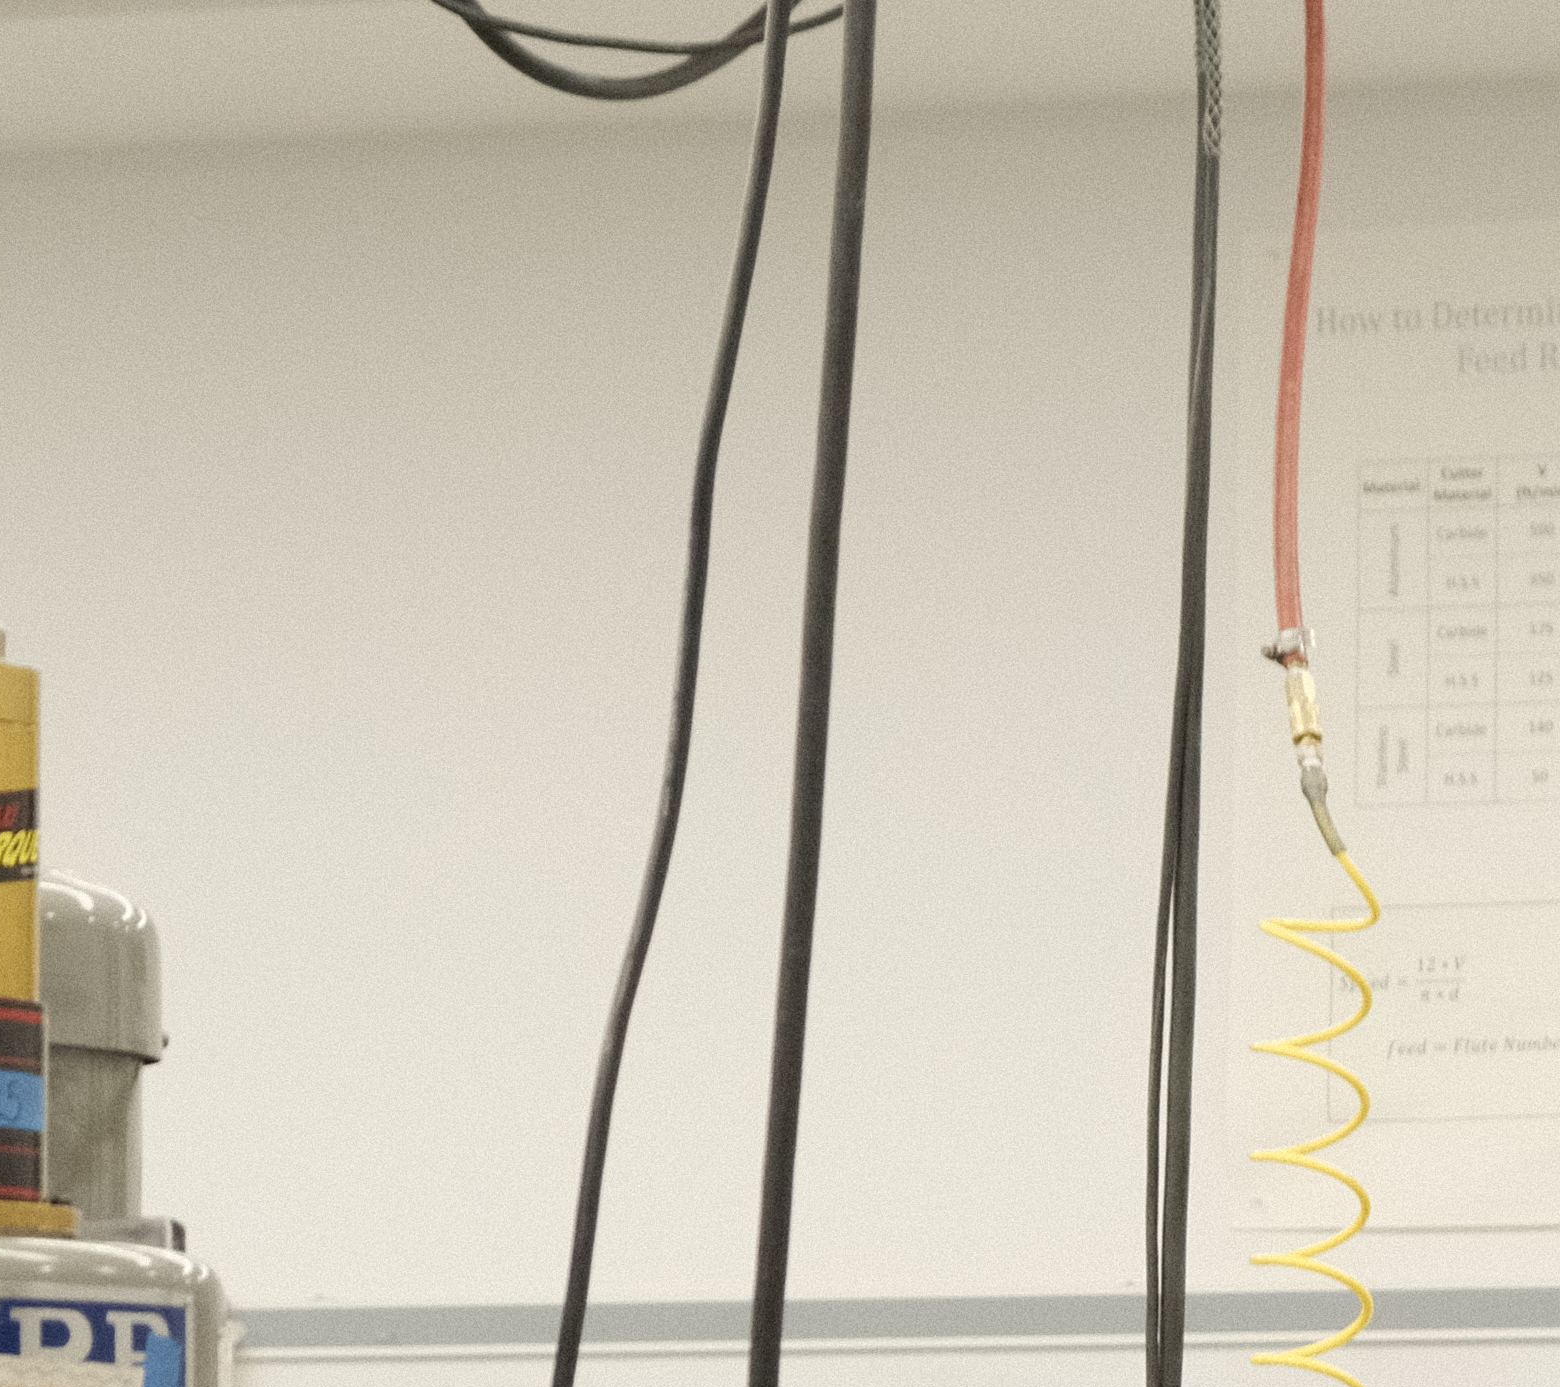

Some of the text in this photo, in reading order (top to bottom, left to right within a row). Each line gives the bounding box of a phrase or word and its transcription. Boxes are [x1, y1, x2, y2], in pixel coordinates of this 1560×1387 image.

[1315, 306, 1381, 337] How
[1393, 307, 1422, 331] to
[1456, 343, 1528, 375] Feed
